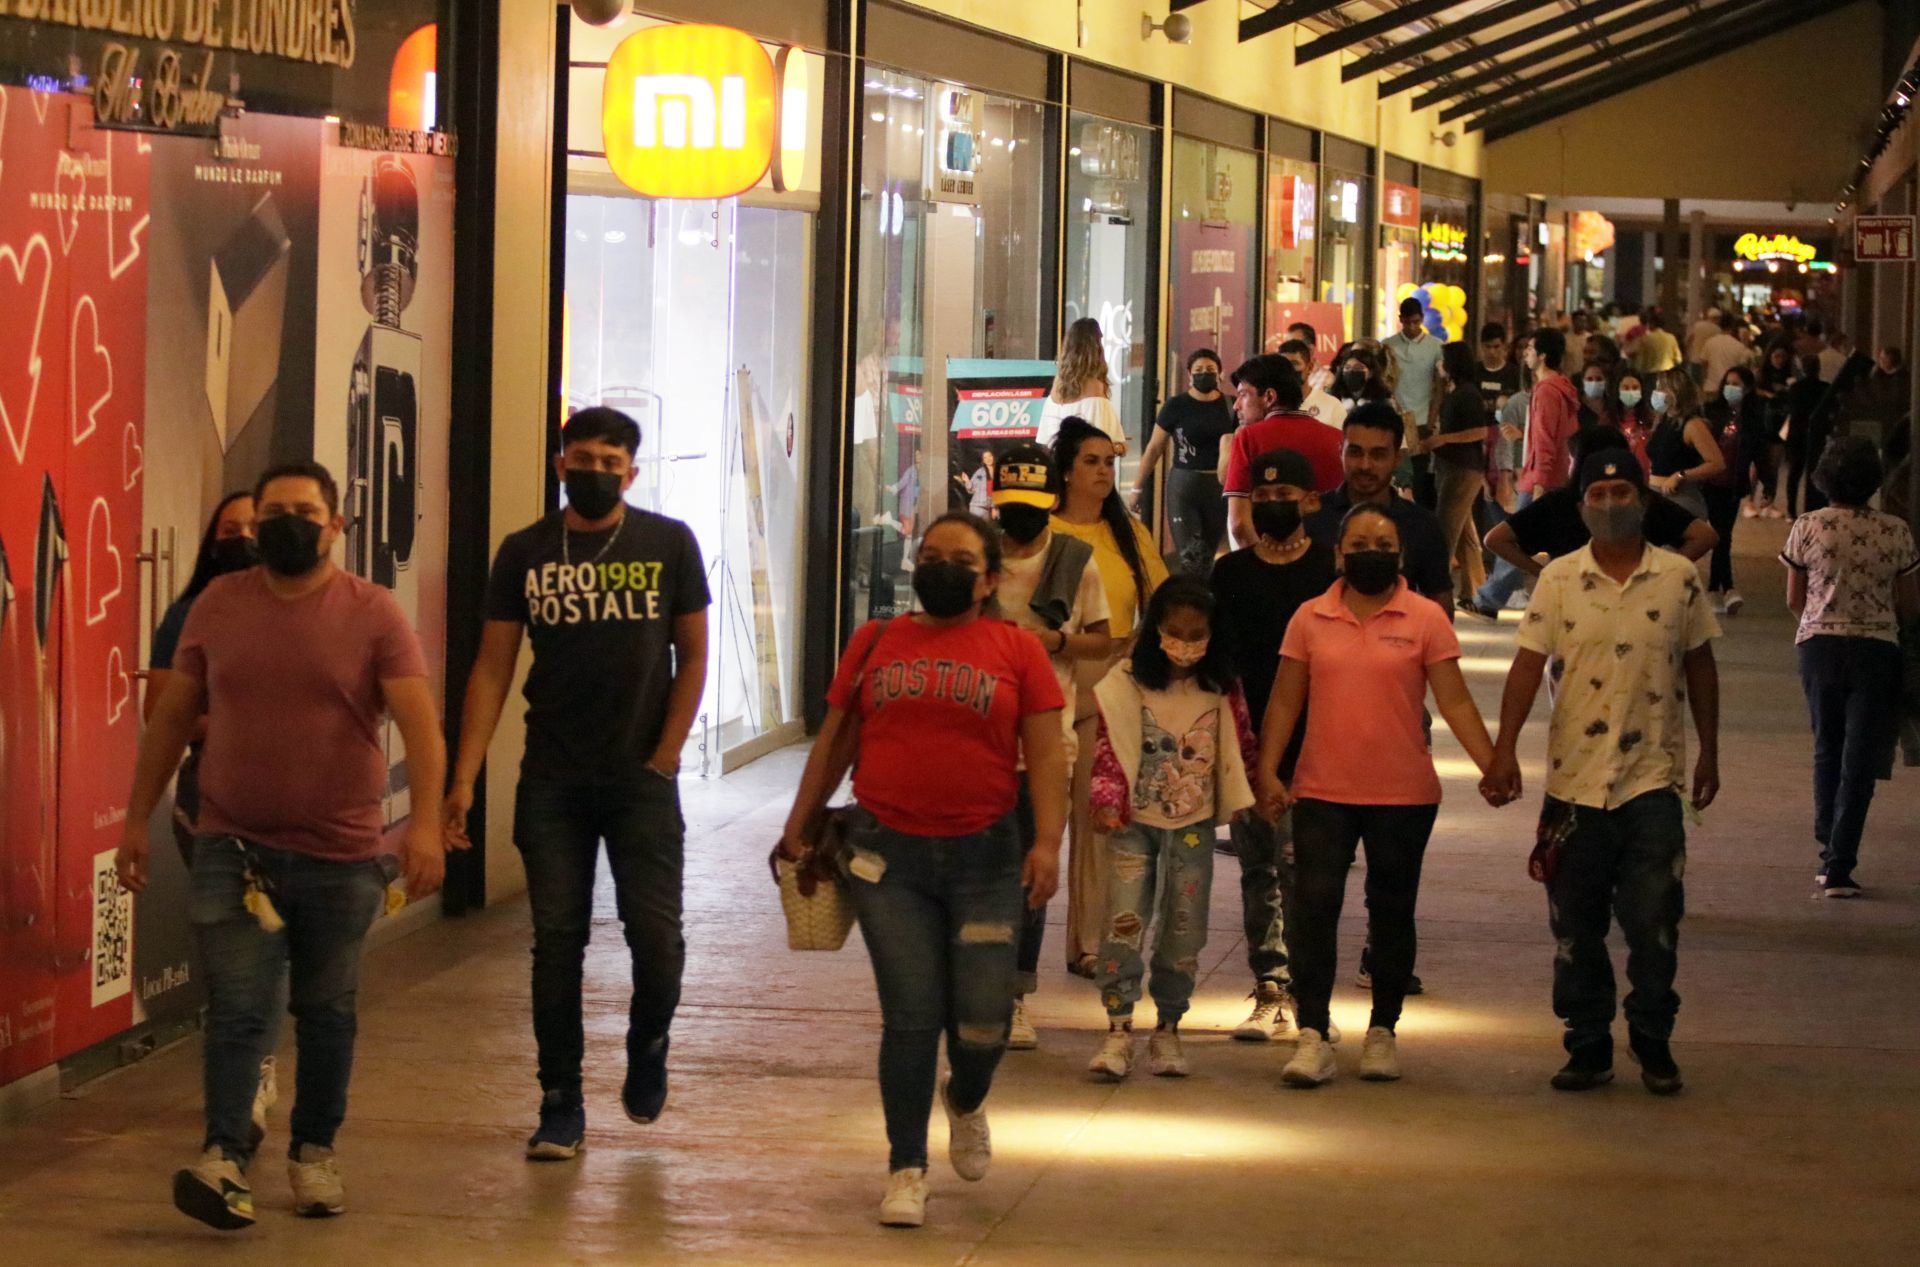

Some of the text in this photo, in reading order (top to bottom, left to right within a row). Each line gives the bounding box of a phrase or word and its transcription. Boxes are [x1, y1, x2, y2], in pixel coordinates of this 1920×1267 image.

[230, 167, 243, 184] LE
[971, 400, 1031, 428] 60%
[525, 561, 664, 598] AERO 1987
[528, 590, 661, 625] POSTALE
[873, 659, 998, 719] BOSTON
